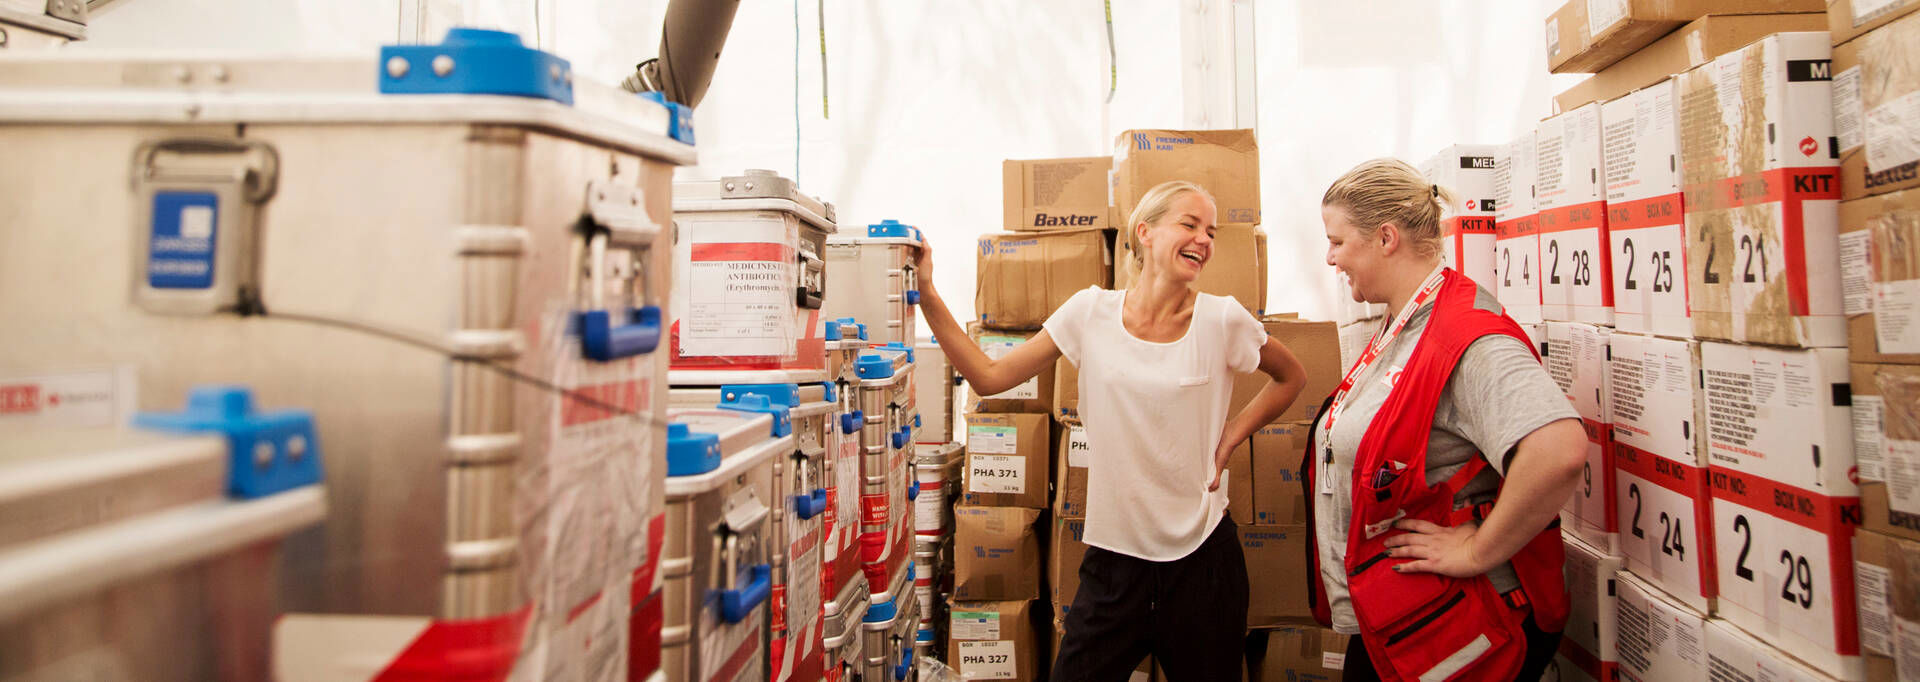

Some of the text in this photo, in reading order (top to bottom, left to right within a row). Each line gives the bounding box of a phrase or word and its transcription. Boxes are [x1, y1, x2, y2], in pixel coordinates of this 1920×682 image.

[1809, 62, 1832, 79] M
[1794, 174, 1833, 193] KIT
[1034, 213, 1098, 227] Baxter
[1462, 219, 1483, 230] KIT
[1549, 239, 1590, 286] 2 28
[1623, 237, 1673, 293] 2 25
[1700, 221, 1767, 284] 2 21
[1503, 248, 1530, 287] 2 4
[1071, 441, 1089, 450] PH
[973, 468, 1018, 478] PHA 371
[1712, 471, 1728, 491] KIT
[1774, 488, 1796, 512] BOX
[1629, 483, 1685, 562] 2 24
[1733, 514, 1813, 610] 2 29
[963, 654, 1008, 664] PHA 327
